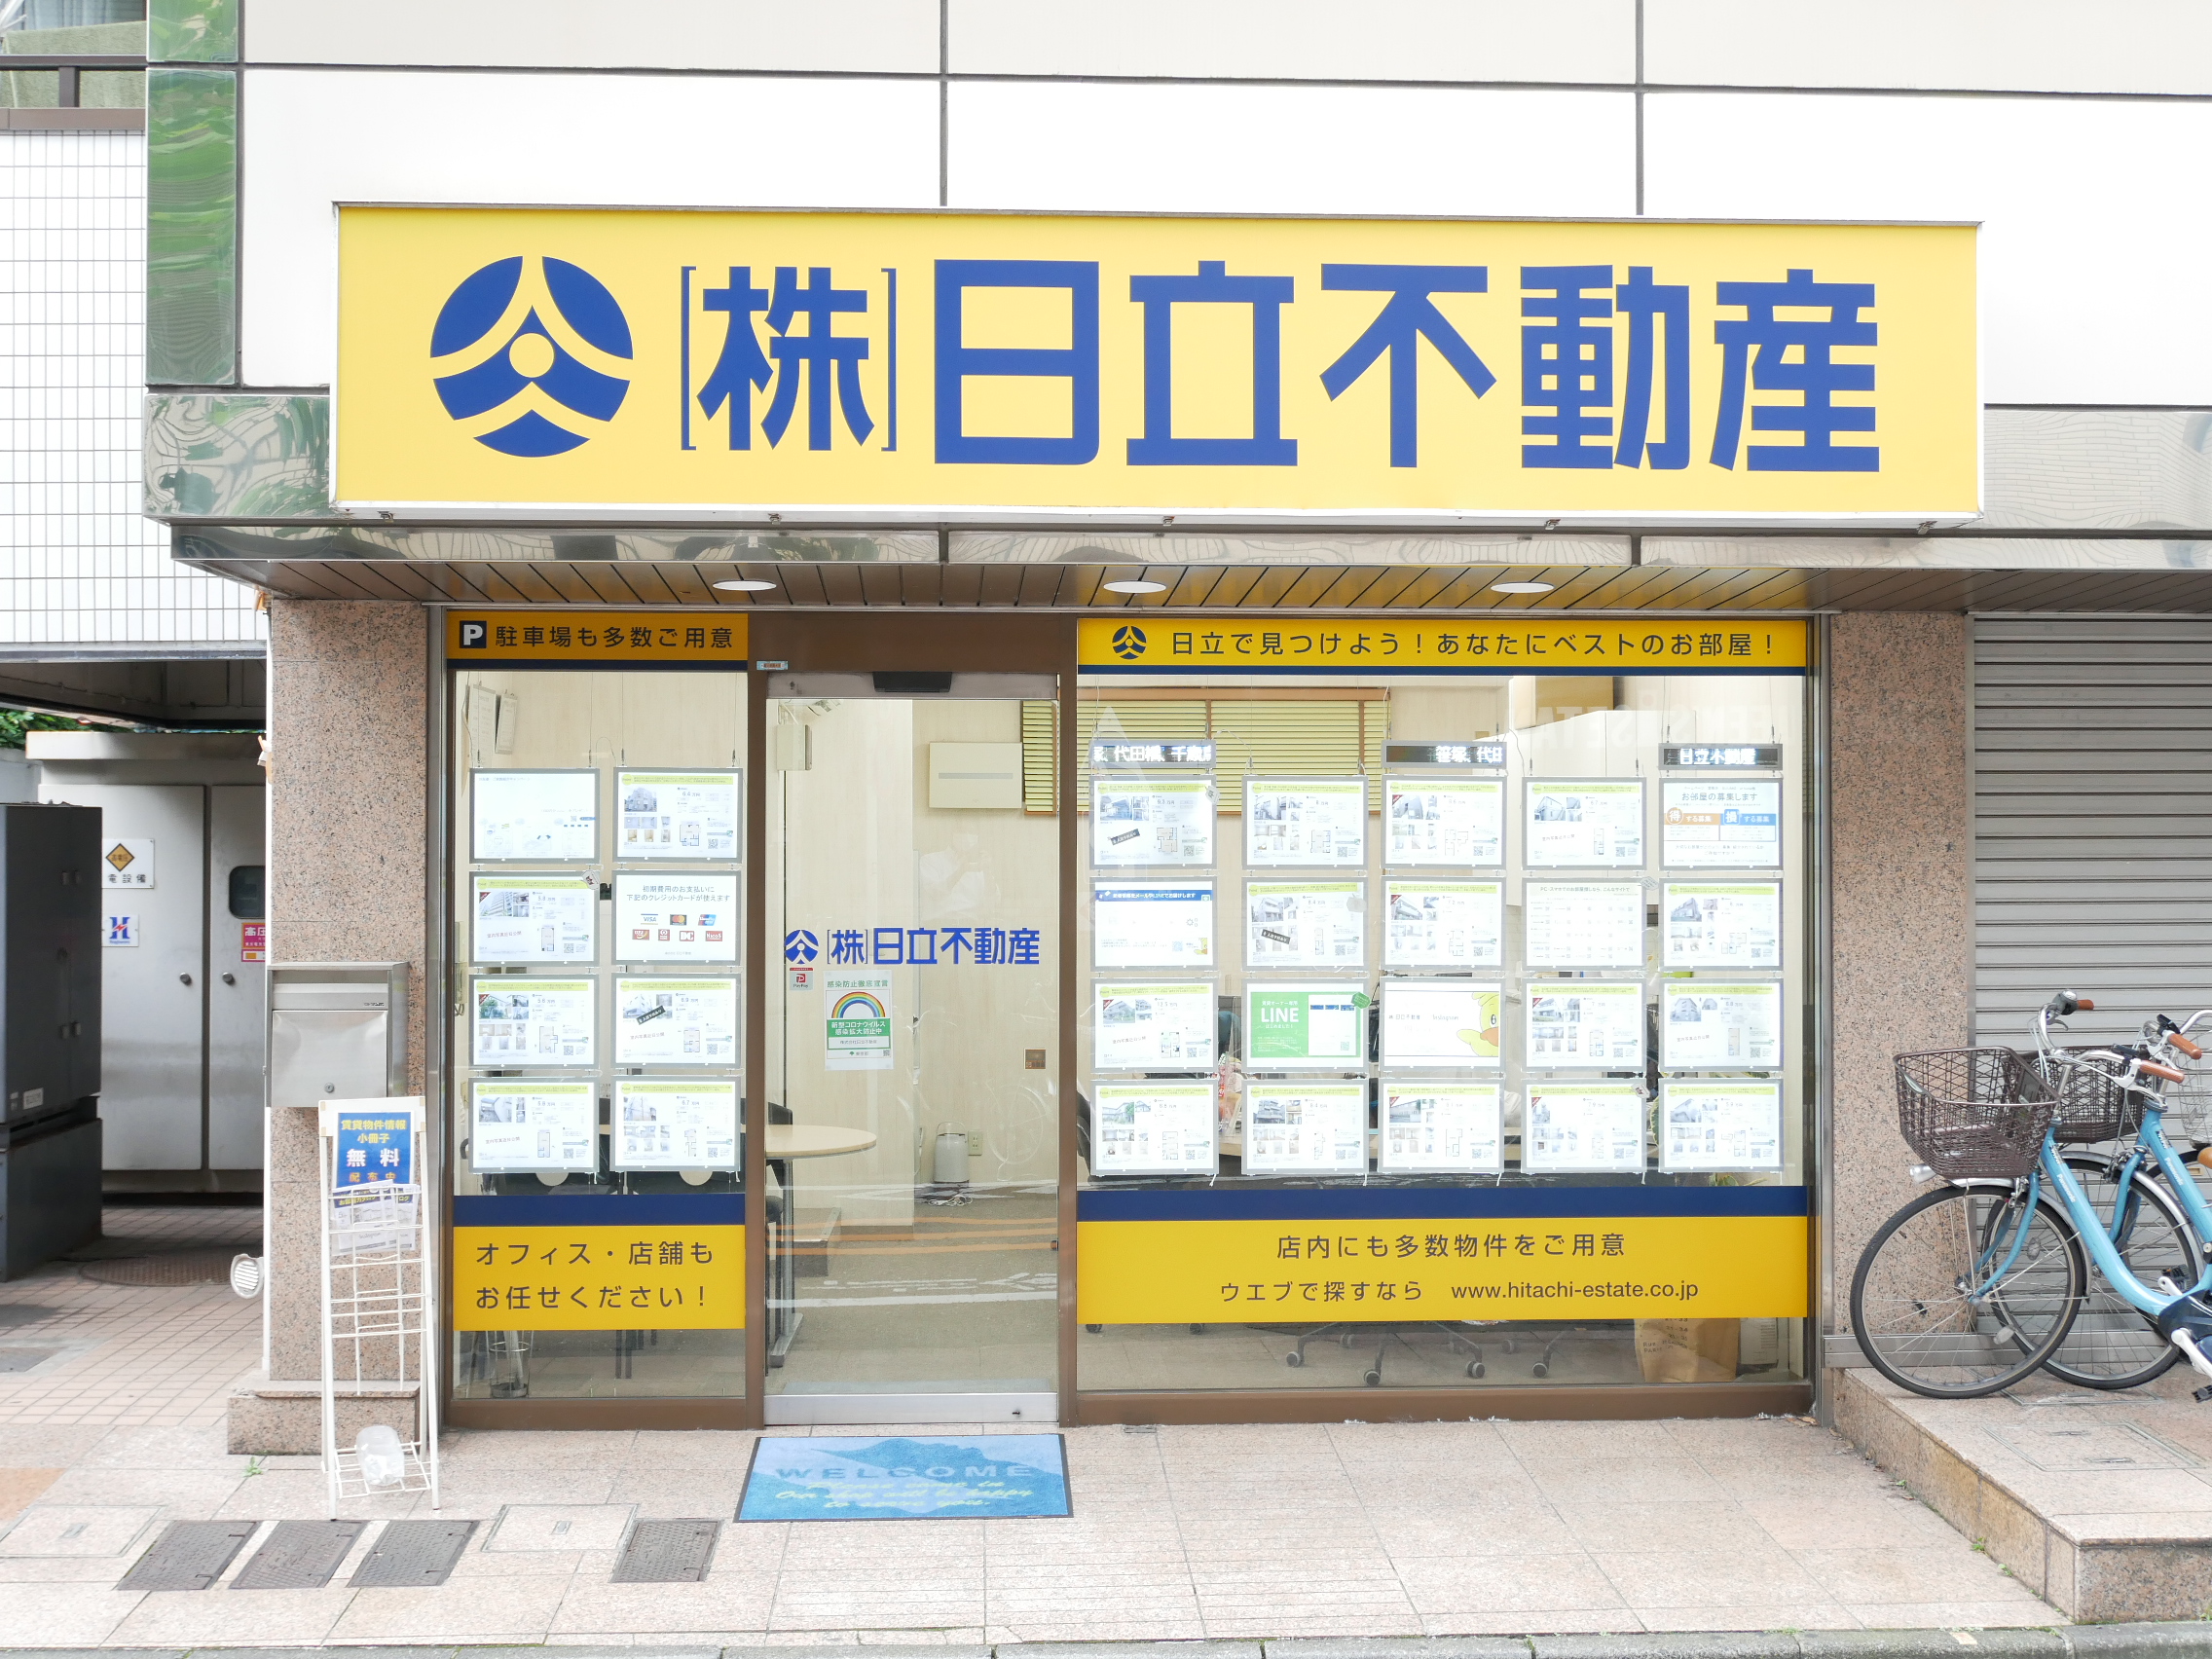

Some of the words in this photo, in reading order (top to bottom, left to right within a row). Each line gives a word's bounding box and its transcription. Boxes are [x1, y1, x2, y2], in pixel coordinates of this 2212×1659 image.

[463, 624, 483, 645] P
[495, 626, 733, 648] 駐車場も多数ご用意
[1261, 1008, 1300, 1023] LINE
[341, 1120, 407, 1131] 賃貸物件情報
[357, 1132, 390, 1144] 小冊子
[2163, 1157, 2184, 1186] Panasonic
[2056, 1173, 2077, 1203] Panasonic
[476, 1241, 714, 1266] オフィス・店舗も
[1276, 1233, 1626, 1260] 店内にも多数物件をご用意
[476, 1285, 704, 1310] お任せください！
[1221, 1280, 1421, 1303] ウエブで探すなら
[1451, 1281, 1699, 1301] www.hitachi-estate.co.jp
[776, 1465, 1032, 1479] WELCOME
